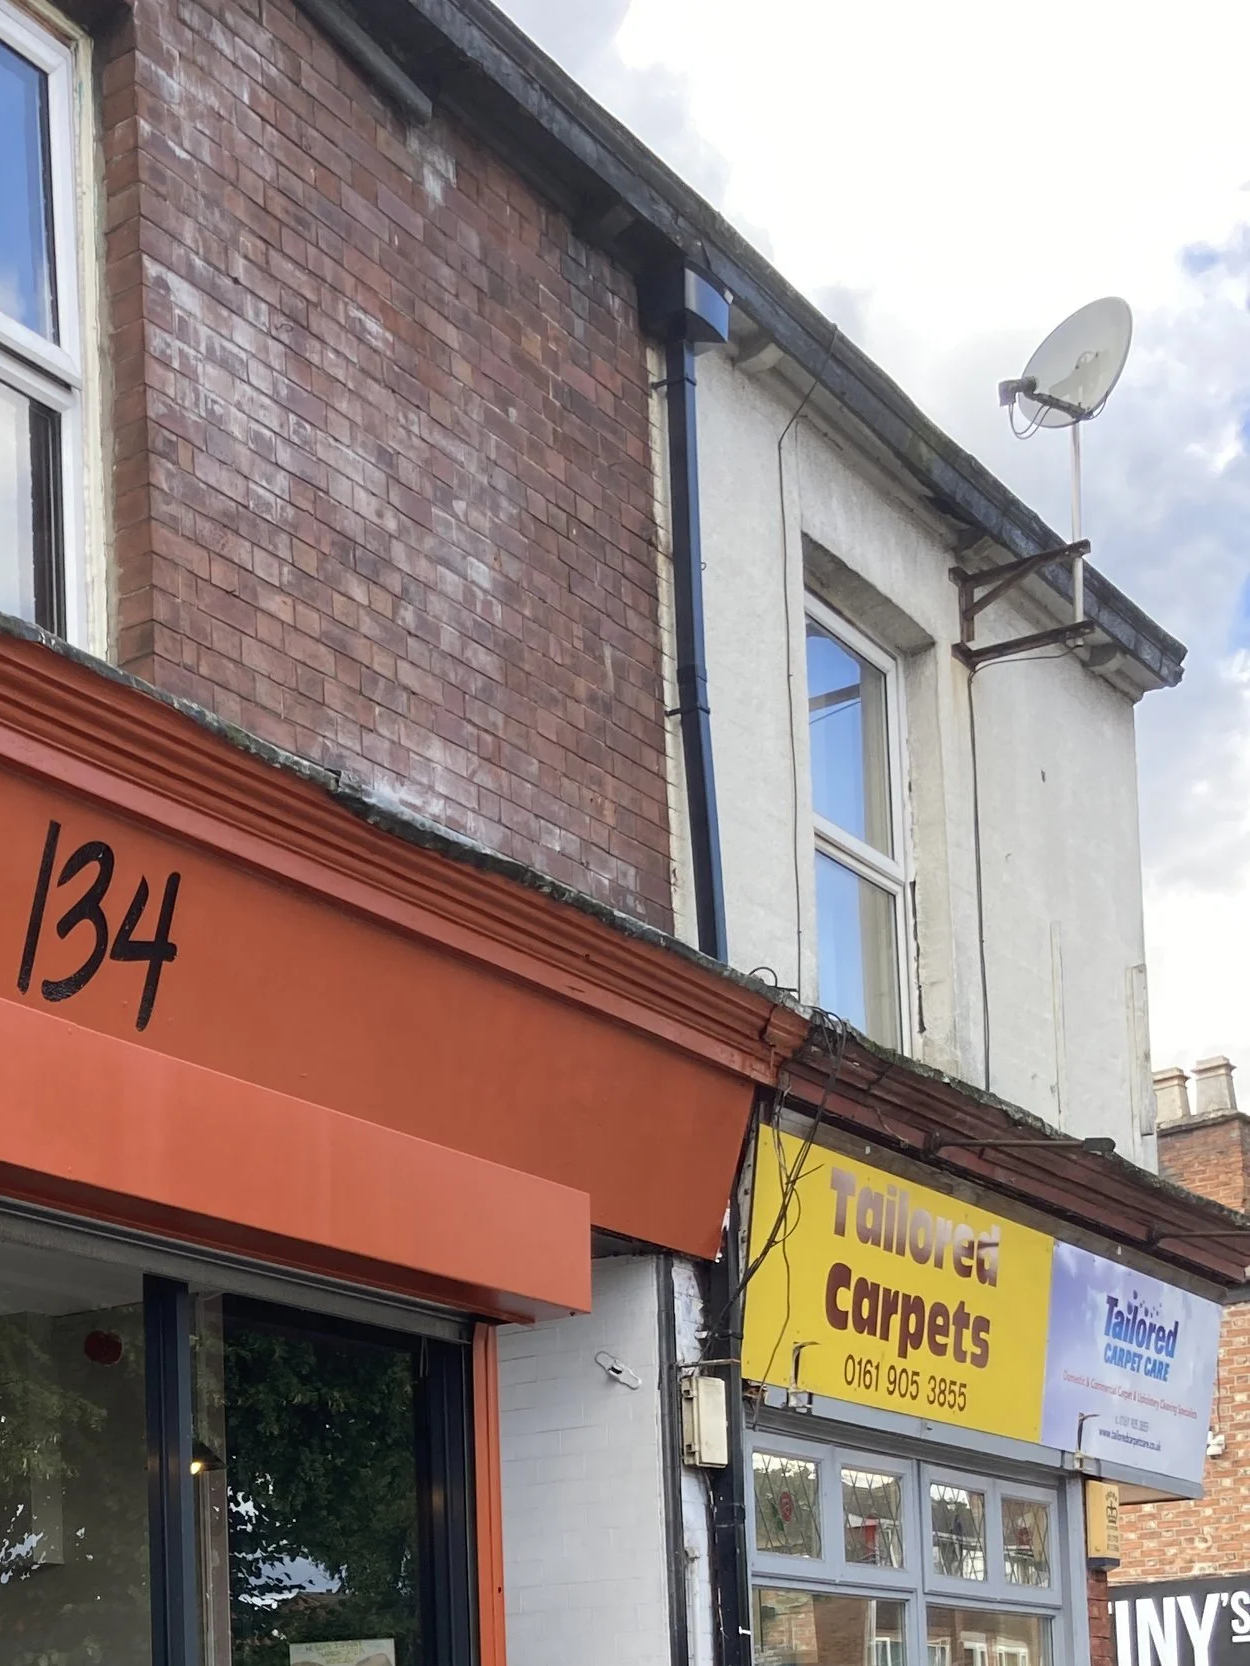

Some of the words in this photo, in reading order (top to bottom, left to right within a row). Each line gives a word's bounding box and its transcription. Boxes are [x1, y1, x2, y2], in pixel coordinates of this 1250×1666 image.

[16, 819, 181, 1032] 134
[831, 1167, 1001, 1288] Tailored
[825, 1262, 990, 1370] Carpets
[1104, 1295, 1179, 1359] Tailored
[843, 1354, 880, 1392] 0161
[887, 1364, 920, 1401] 905
[926, 1374, 967, 1412] 3855
[1104, 1343, 1143, 1373] CARPET
[1144, 1356, 1171, 1382] CARE
